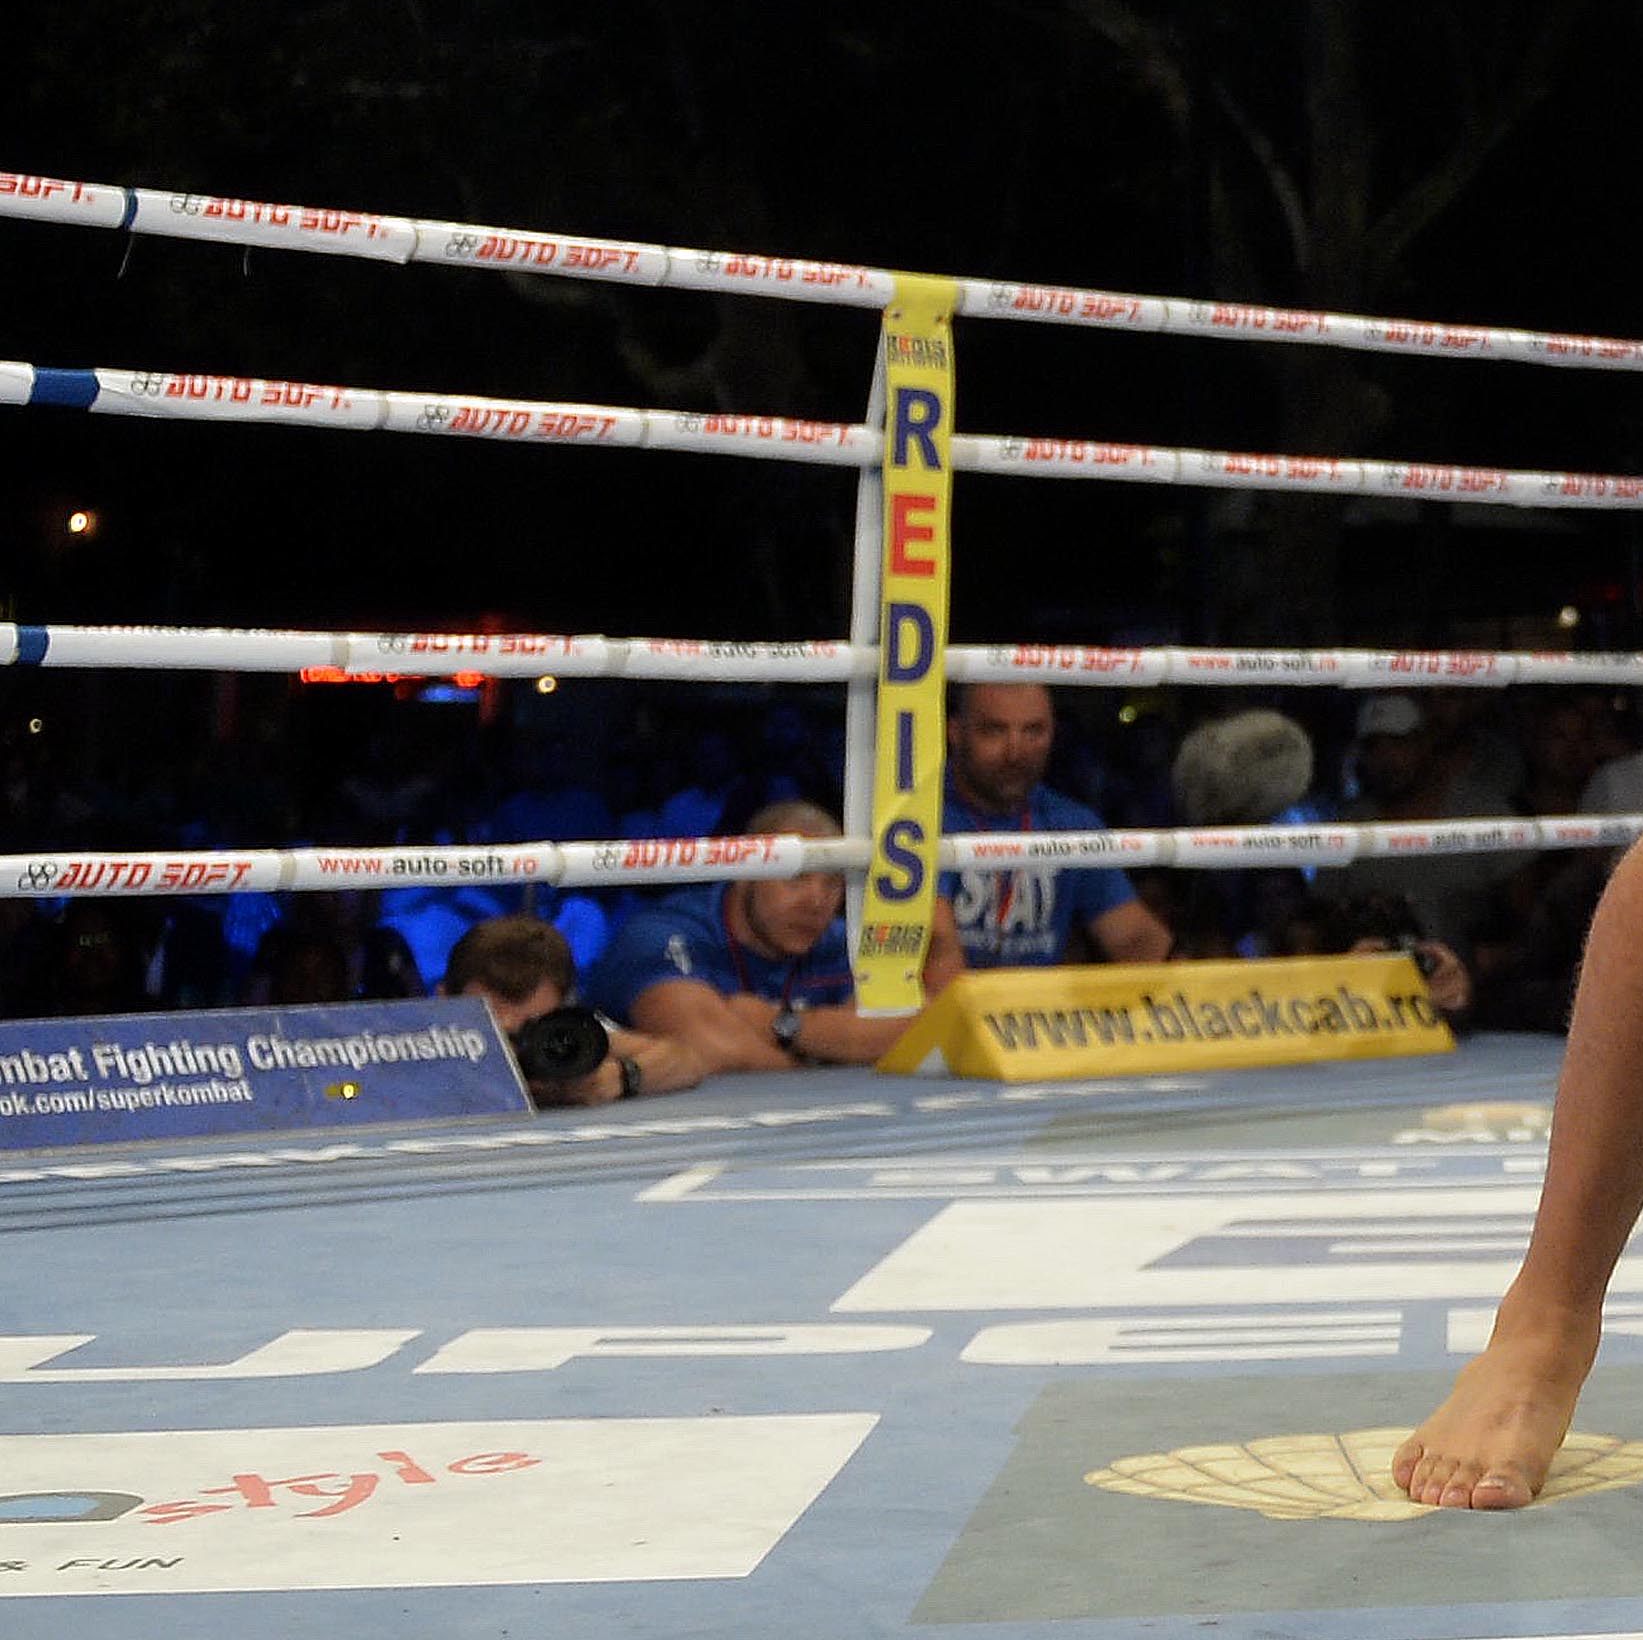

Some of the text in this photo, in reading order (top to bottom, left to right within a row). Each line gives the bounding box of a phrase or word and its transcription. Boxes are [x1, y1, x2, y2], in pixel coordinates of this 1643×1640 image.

[875, 387, 941, 902] REDIS
[56, 862, 152, 889] AUTO
[984, 985, 1440, 1053] www.blackcab.ro
[92, 1040, 244, 1084] Fighting
[247, 1024, 487, 1071] Championship
[139, 1450, 544, 1525] style
[56, 1556, 185, 1572] FUN
